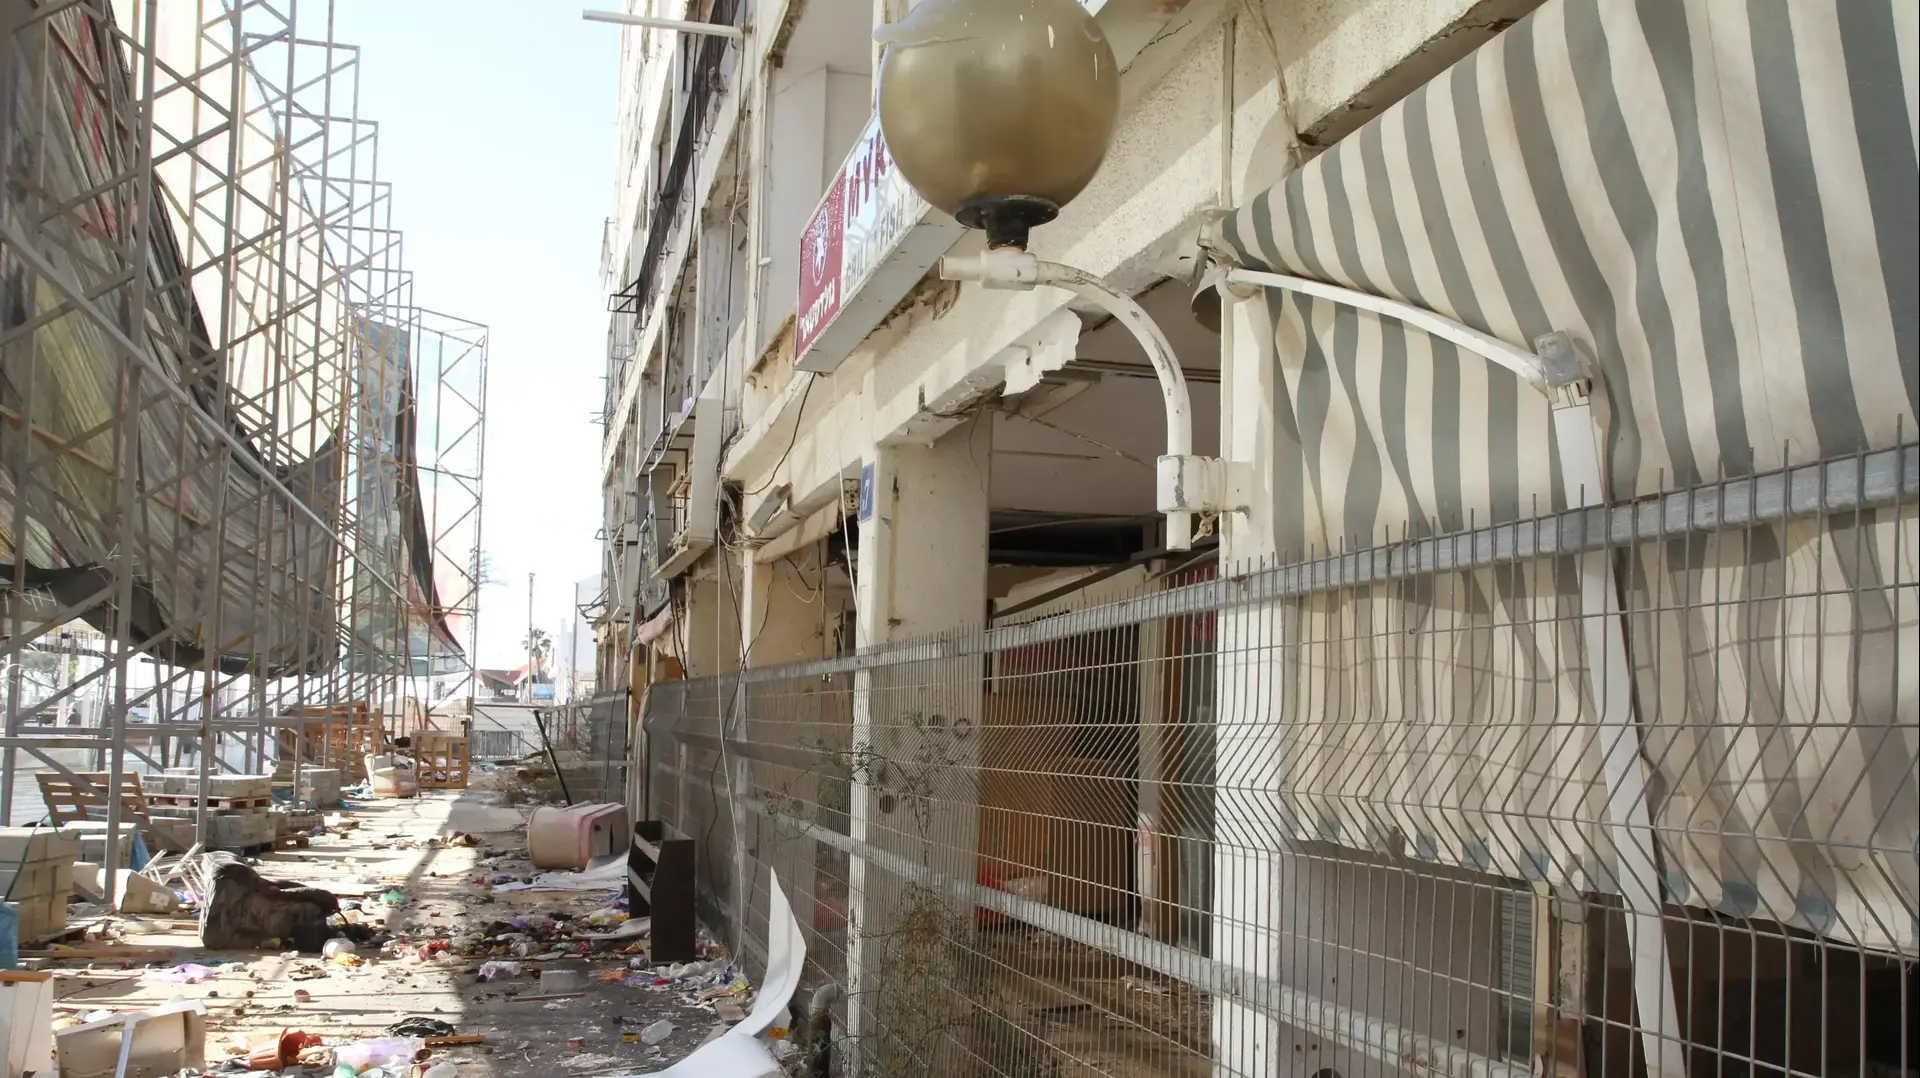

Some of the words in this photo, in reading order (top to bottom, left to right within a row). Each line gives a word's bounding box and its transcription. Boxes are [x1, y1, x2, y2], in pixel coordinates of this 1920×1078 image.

[847, 128, 893, 229] MYK
[845, 240, 869, 294] GRILL
[880, 193, 904, 250] FISH
